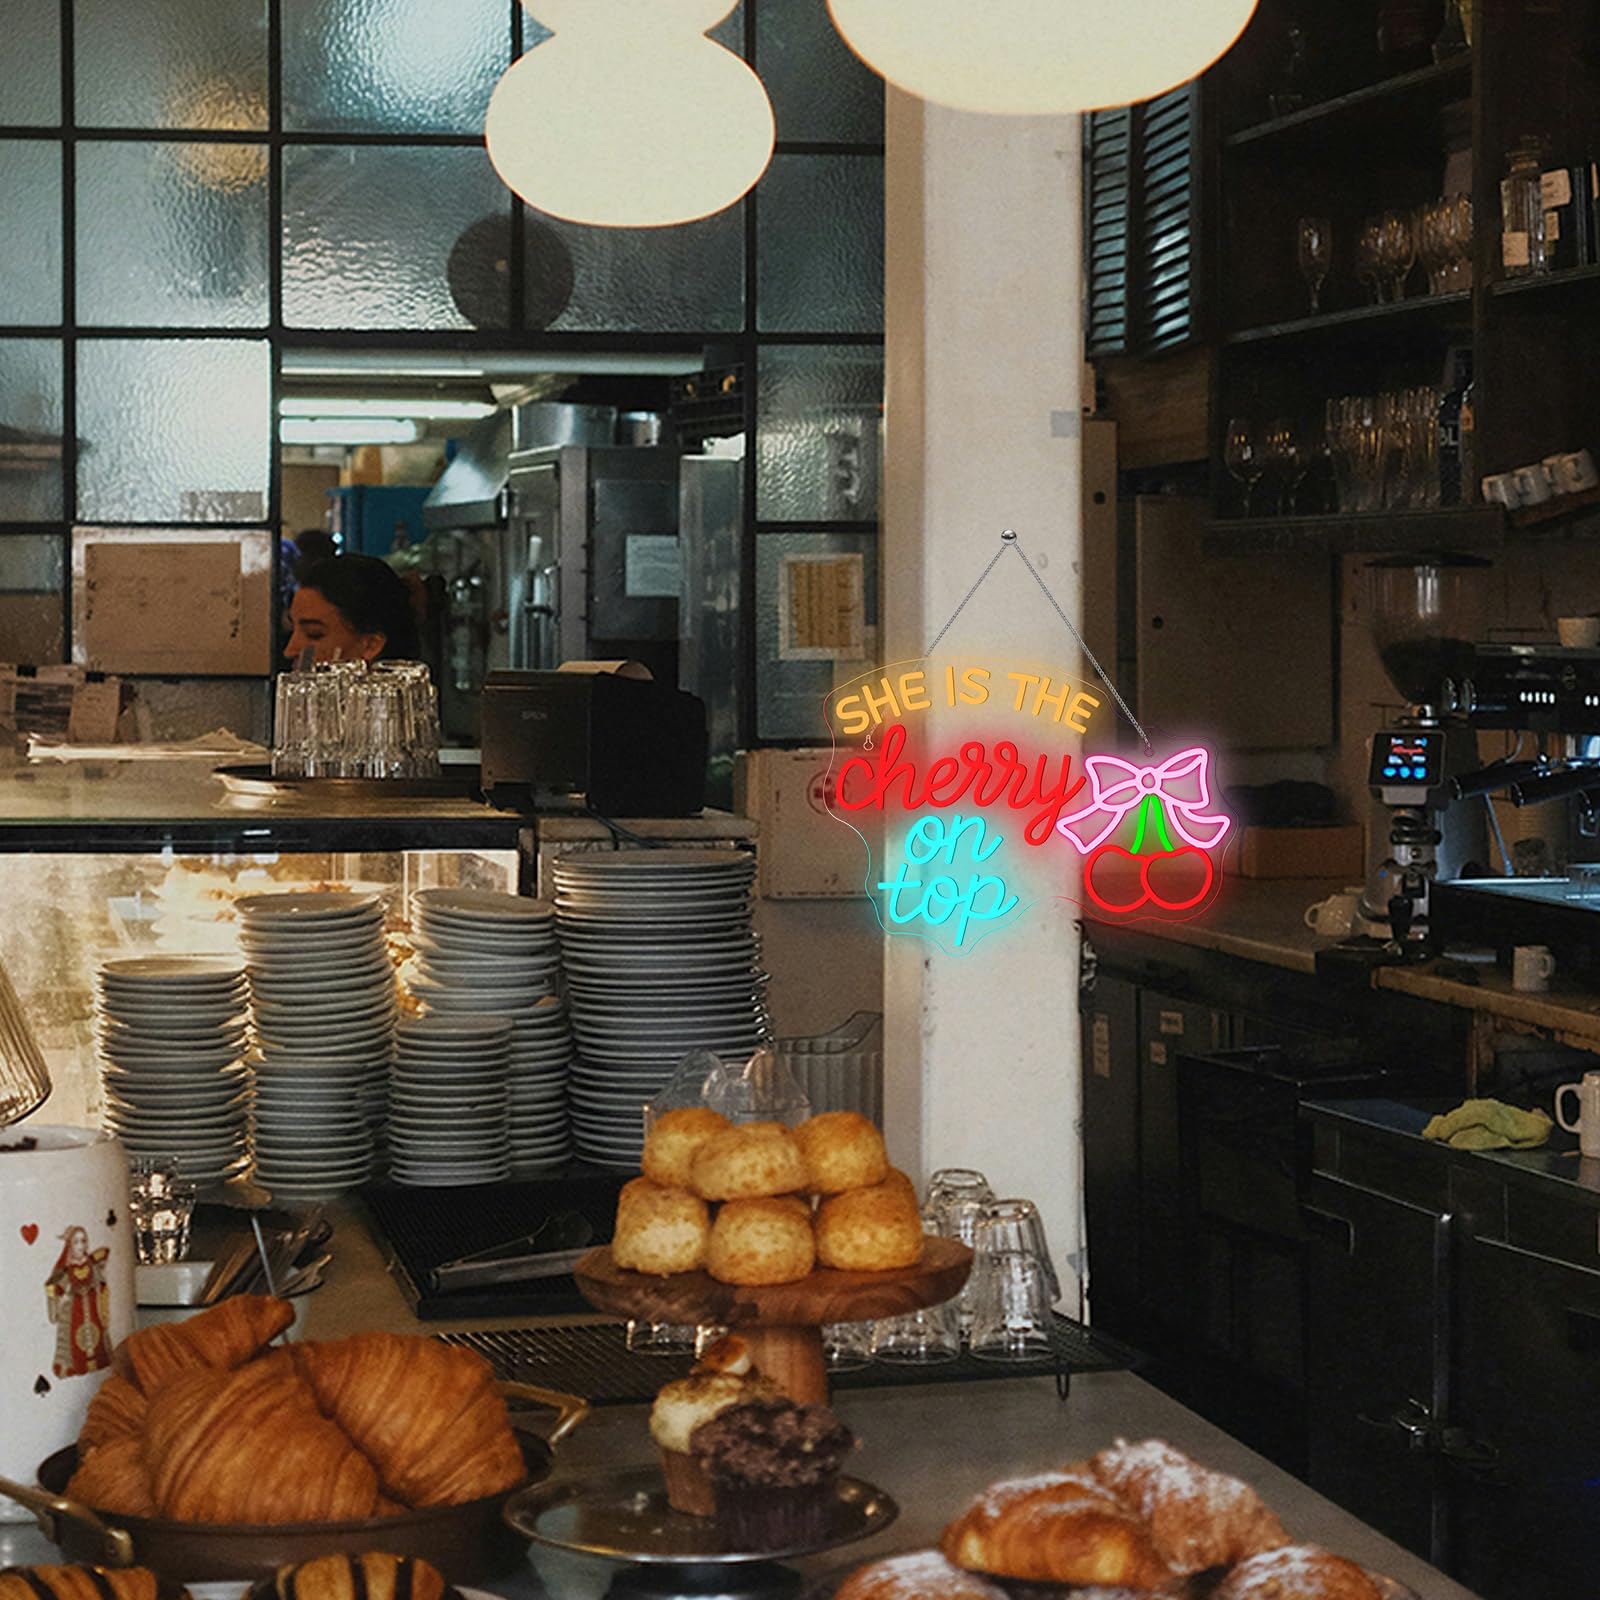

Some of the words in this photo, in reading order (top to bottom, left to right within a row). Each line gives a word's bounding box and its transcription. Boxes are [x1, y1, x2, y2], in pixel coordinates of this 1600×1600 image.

[836, 671, 931, 735] SHE
[947, 666, 991, 706] IS
[1008, 671, 1100, 733] THE
[836, 725, 1086, 846] cherry
[906, 816, 1003, 865] on
[878, 864, 1018, 946] top
